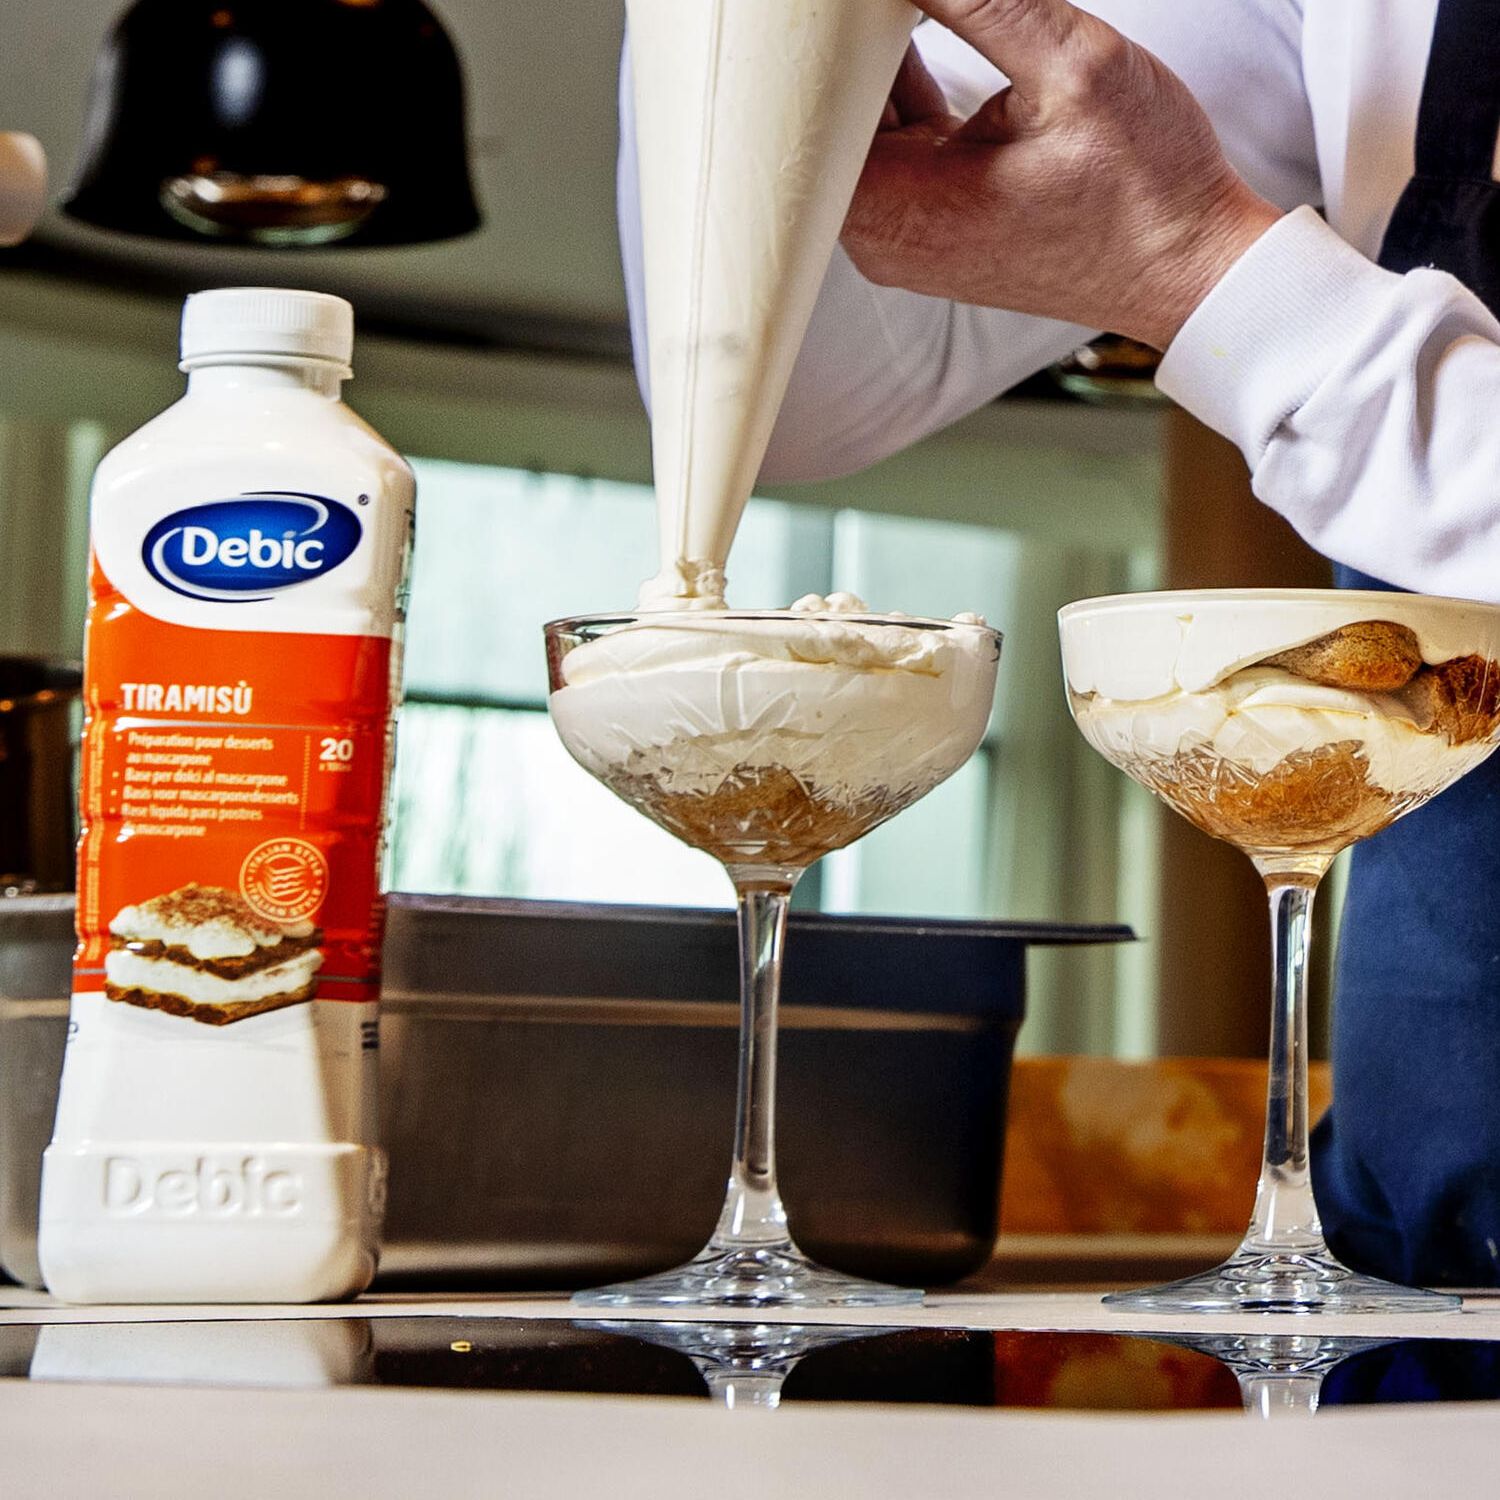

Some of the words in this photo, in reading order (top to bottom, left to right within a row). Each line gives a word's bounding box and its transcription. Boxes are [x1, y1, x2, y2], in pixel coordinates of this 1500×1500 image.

[180, 526, 325, 570] Debic
[319, 737, 354, 761] 20
[103, 1155, 303, 1219] Debic
